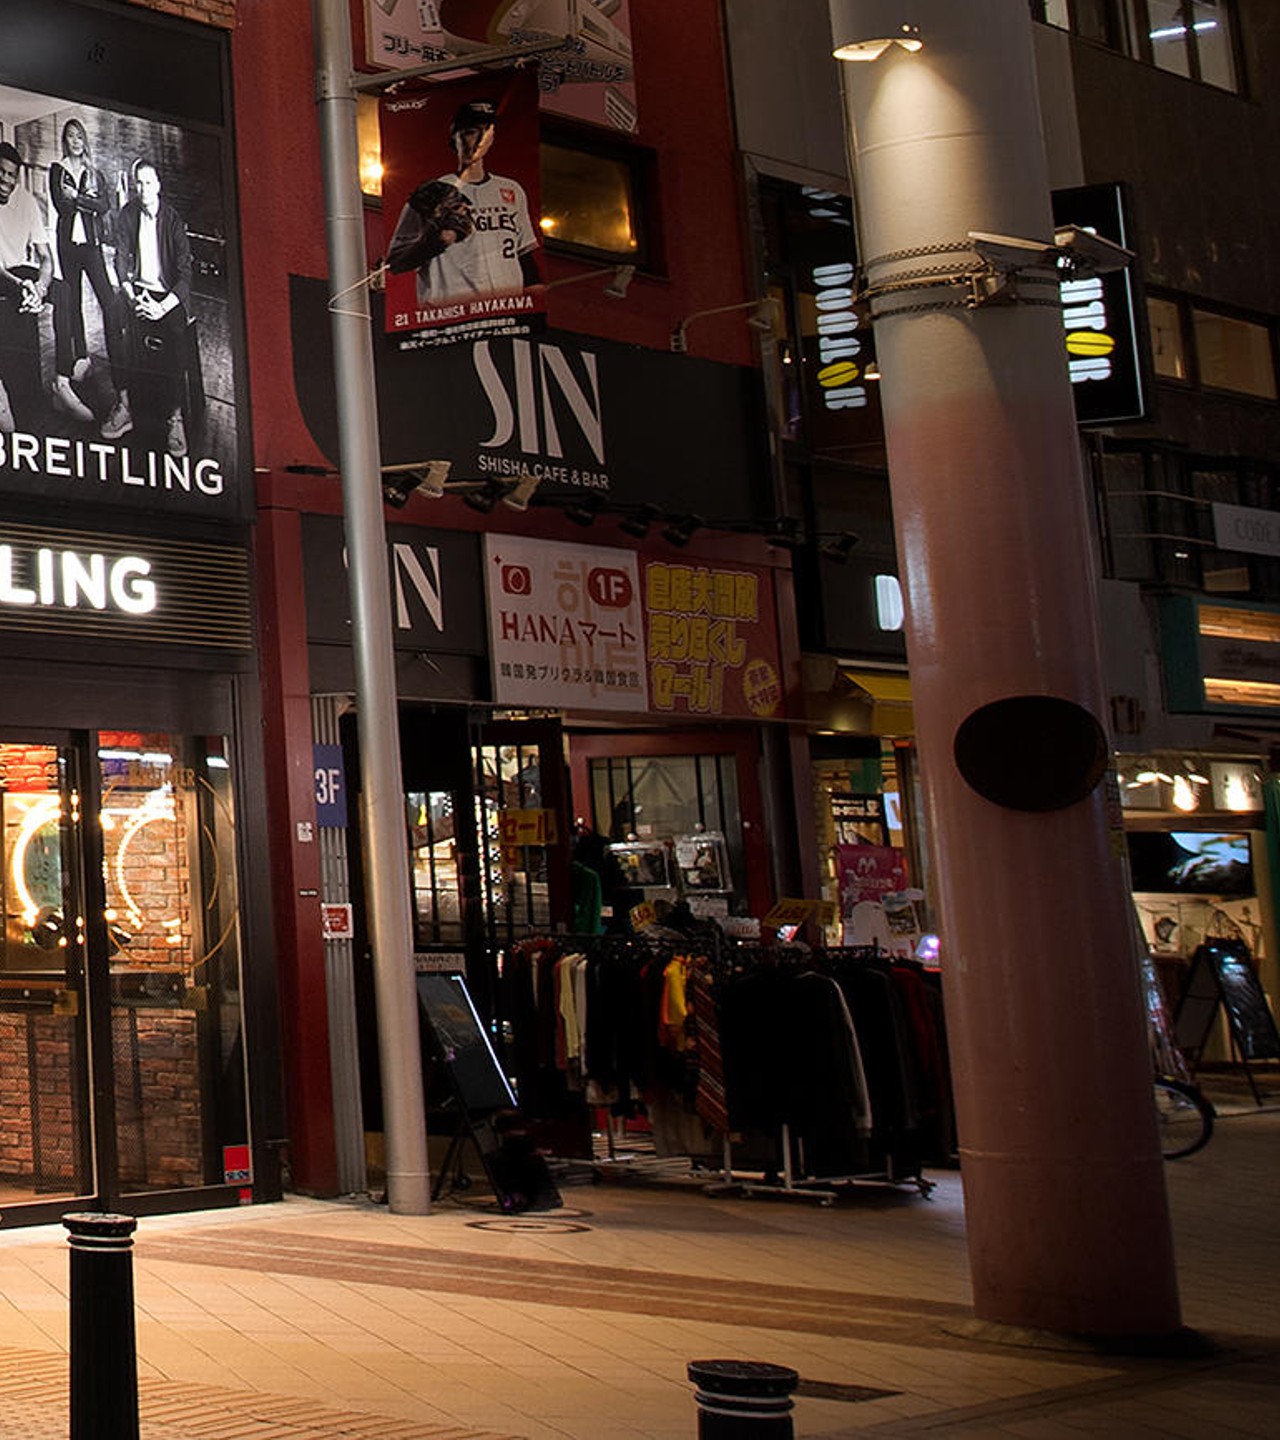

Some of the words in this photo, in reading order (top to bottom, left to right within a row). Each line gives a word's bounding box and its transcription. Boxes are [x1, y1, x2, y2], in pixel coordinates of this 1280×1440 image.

[394, 313, 410, 328] 21
[415, 303, 466, 324] TAKAHISA
[469, 295, 534, 315] HAYAKAWA
[472, 340, 606, 466] SIN
[477, 453, 529, 477] SHISHA
[532, 463, 569, 484] CAFE
[596, 572, 625, 602] 1F
[313, 767, 342, 805] 3F
